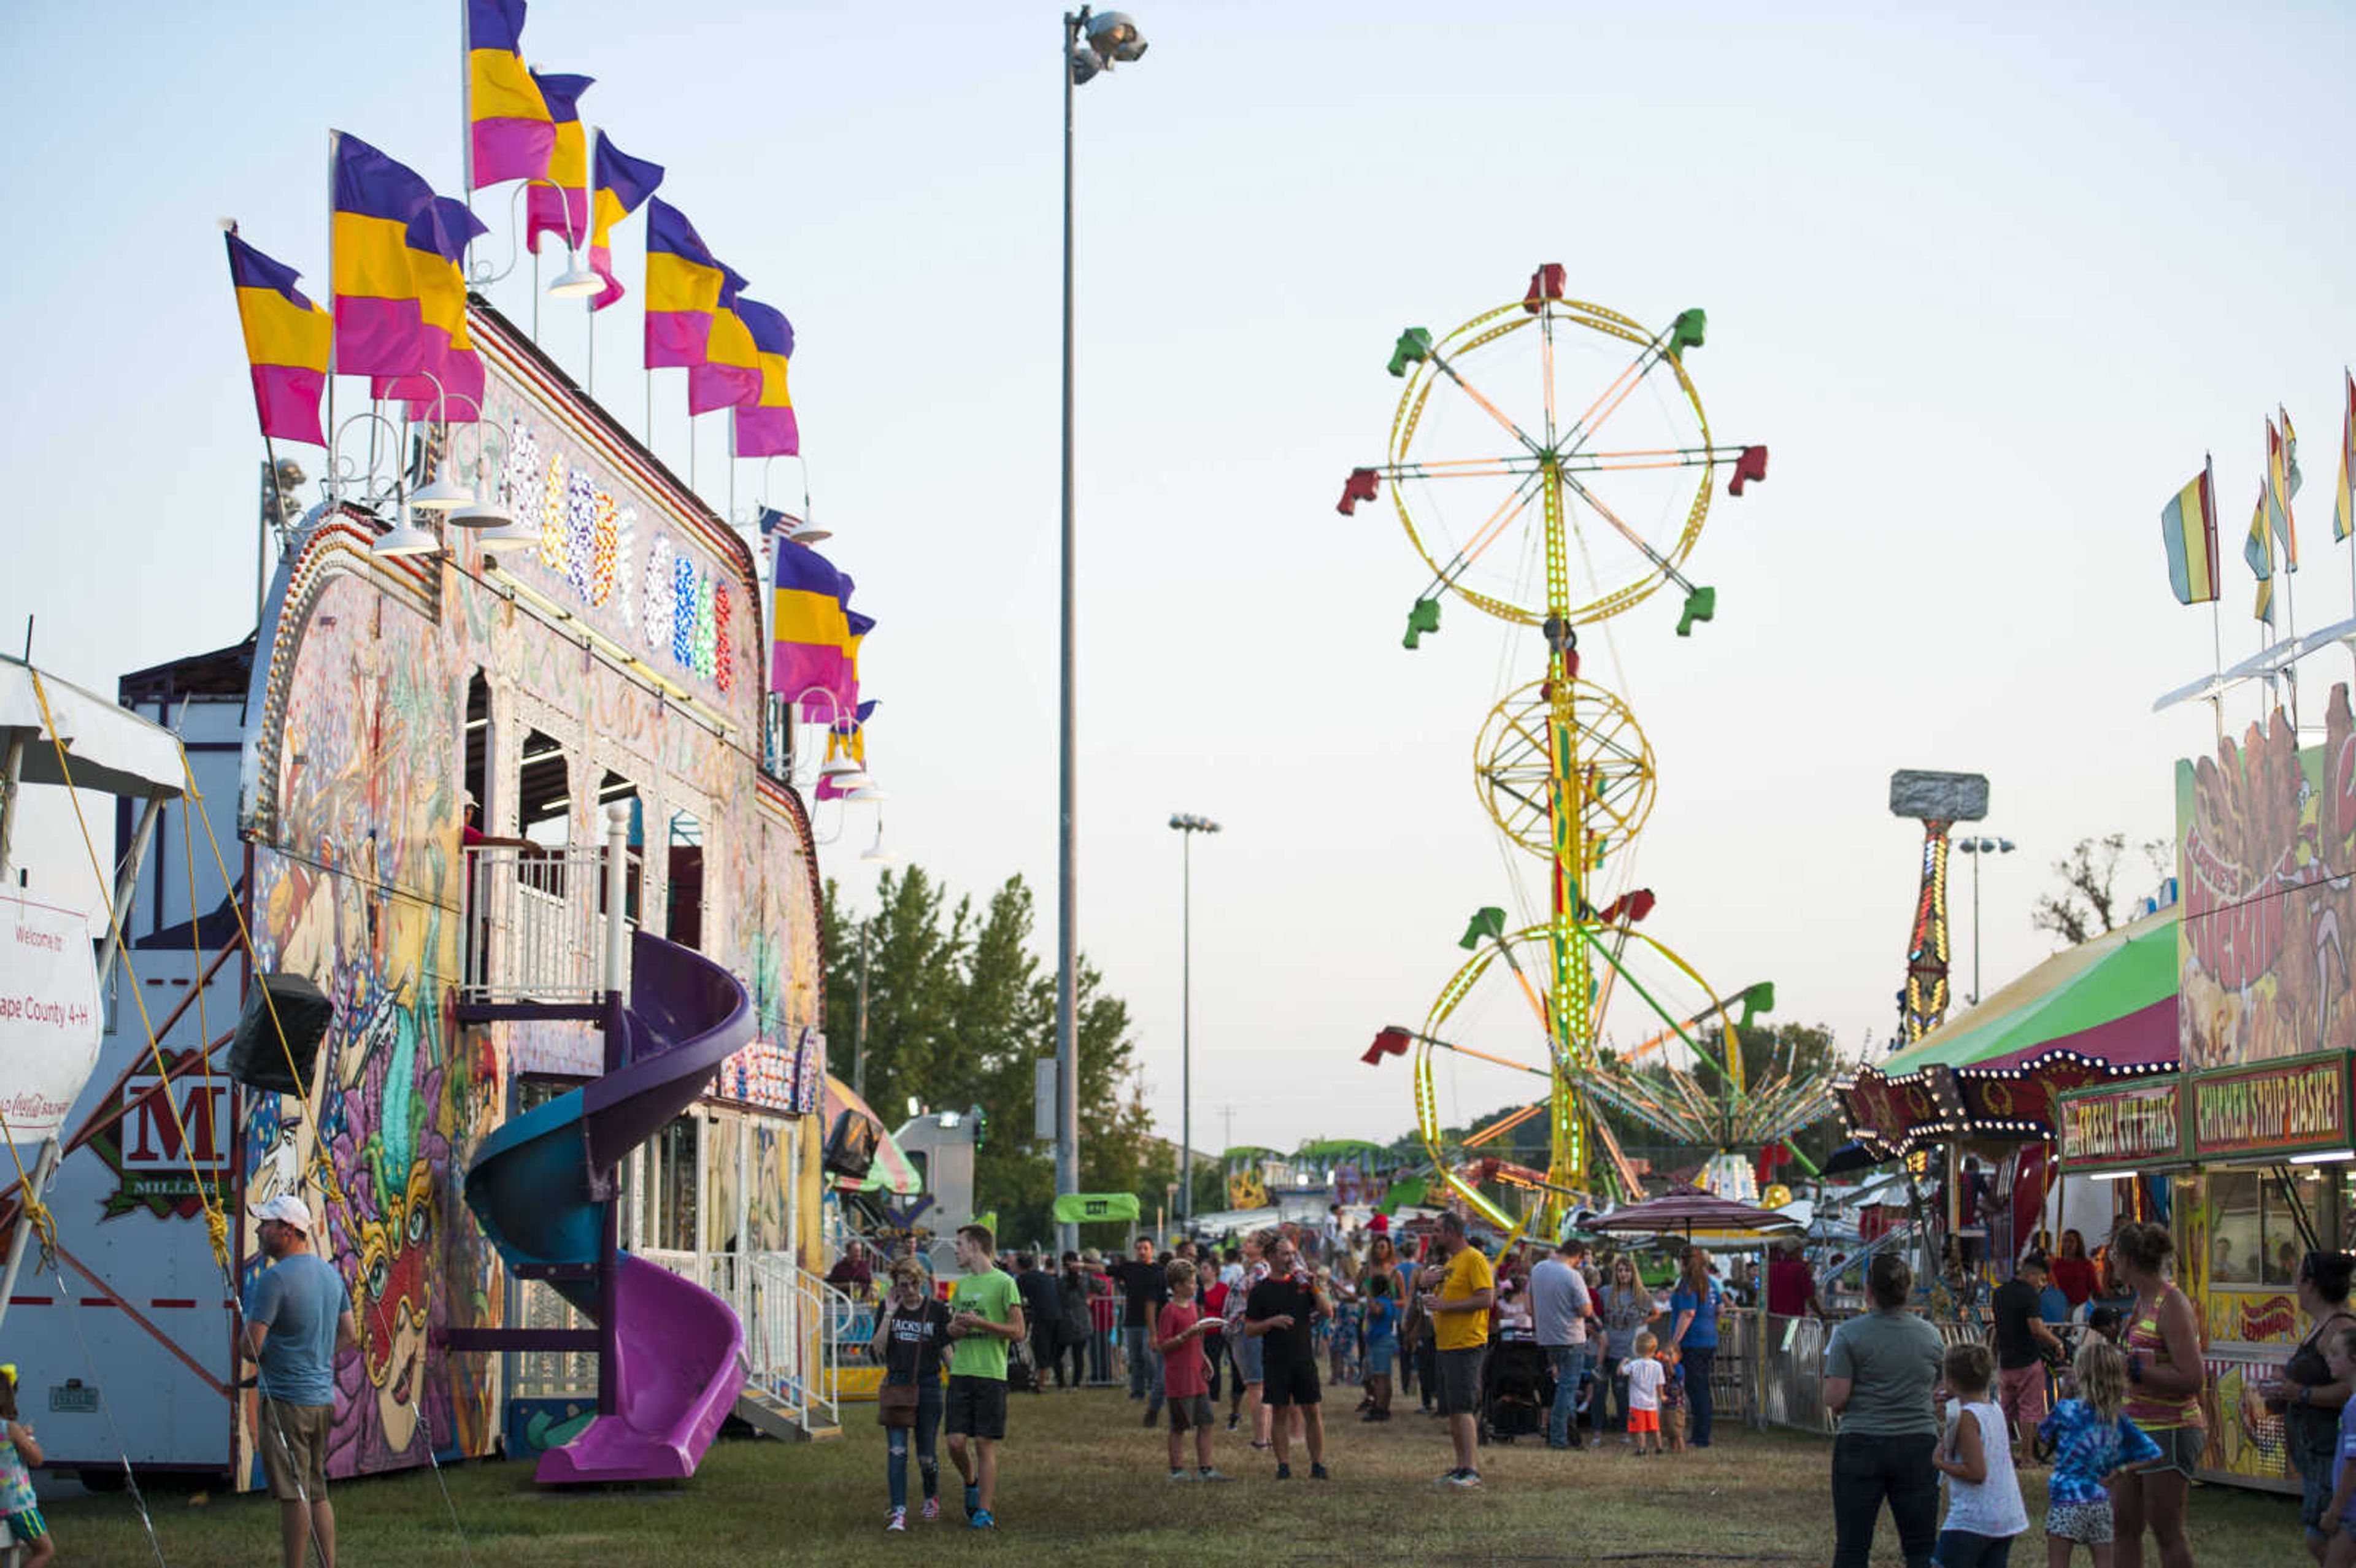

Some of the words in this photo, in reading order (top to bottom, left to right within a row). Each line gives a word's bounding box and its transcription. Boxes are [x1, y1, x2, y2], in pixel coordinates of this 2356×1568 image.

[16, 924, 53, 950] Welcome
[25, 996, 65, 1028] County
[69, 1004, 88, 1026] 4-H
[2198, 1082, 2249, 1142] CHICKEN
[2250, 1077, 2285, 1138] STRIP
[2289, 1070, 2339, 1134] BASKET
[128, 1086, 226, 1161] M
[2078, 1099, 2115, 1156] FRESH
[133, 1178, 217, 1194] MILLER
[1085, 1199, 1108, 1215] EXIT
